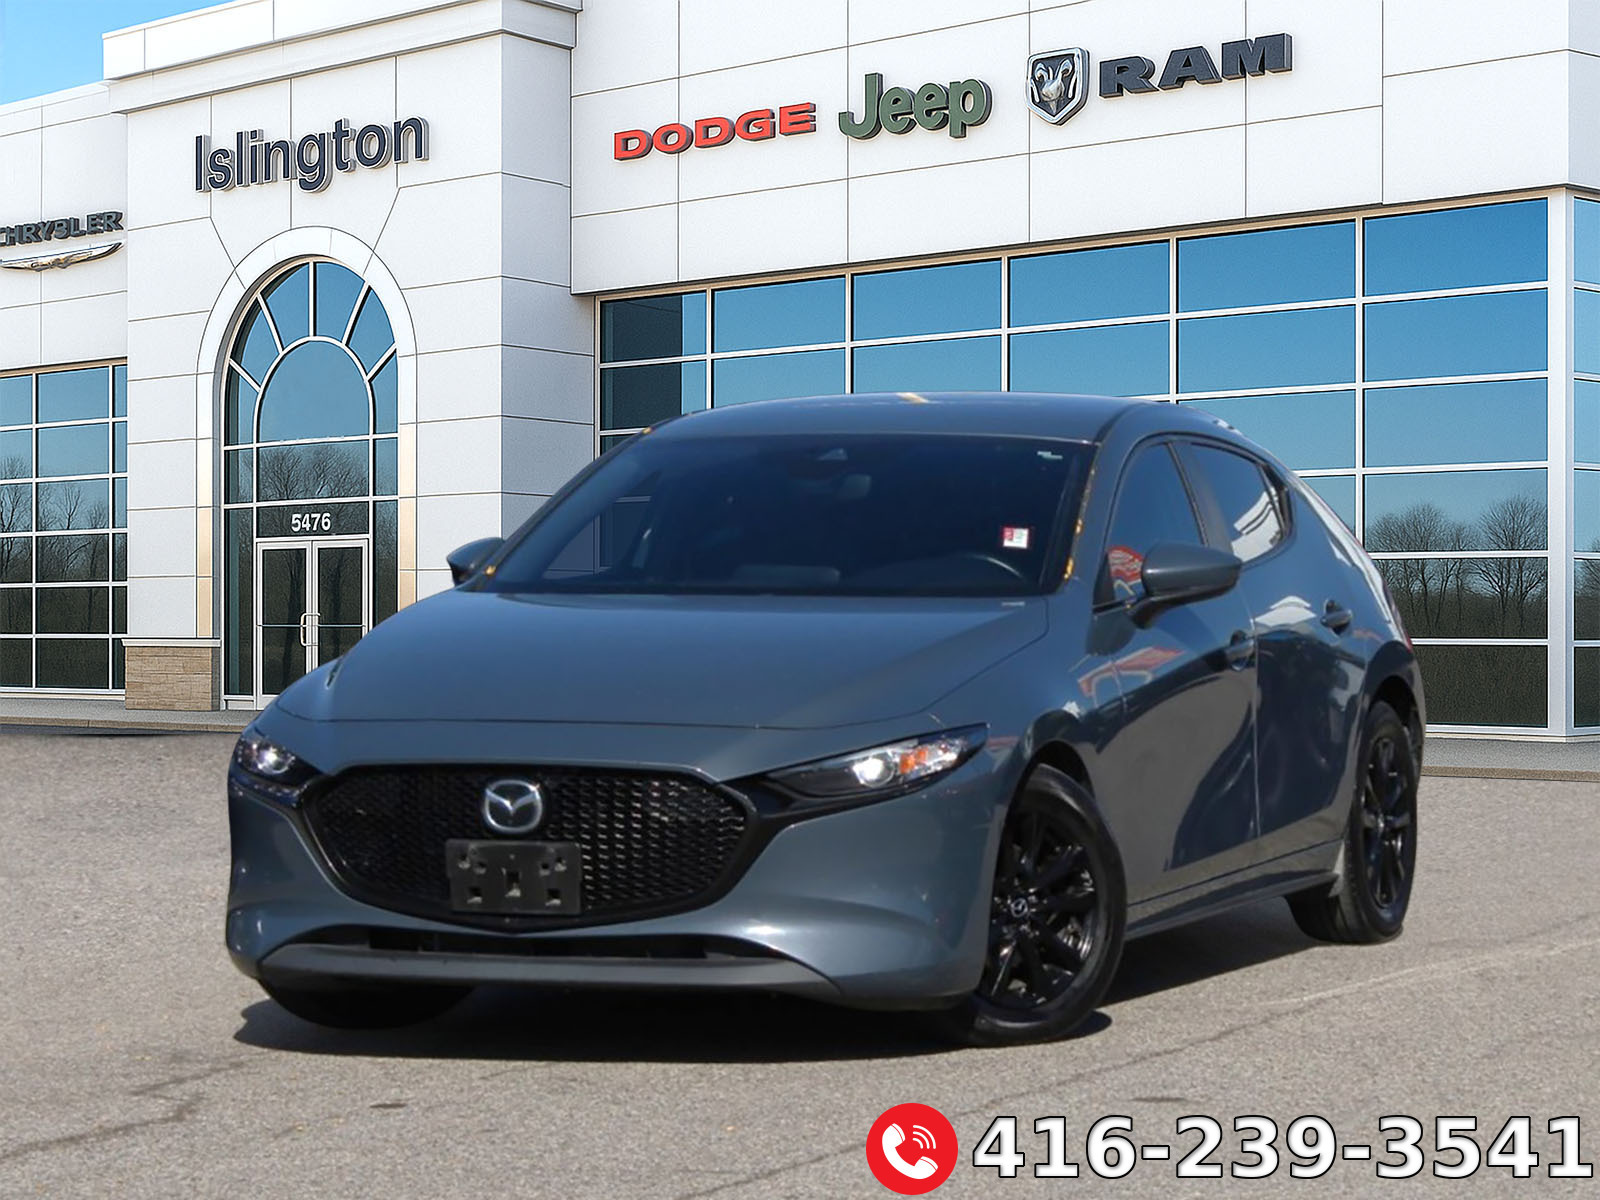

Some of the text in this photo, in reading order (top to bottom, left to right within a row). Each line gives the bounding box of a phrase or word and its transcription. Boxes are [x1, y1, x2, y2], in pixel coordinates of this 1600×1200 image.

[1099, 33, 1293, 98] RAM
[614, 102, 816, 161] DODGE
[838, 72, 992, 139] Jeep
[194, 115, 429, 192] Islington
[291, 512, 331, 532] 5476
